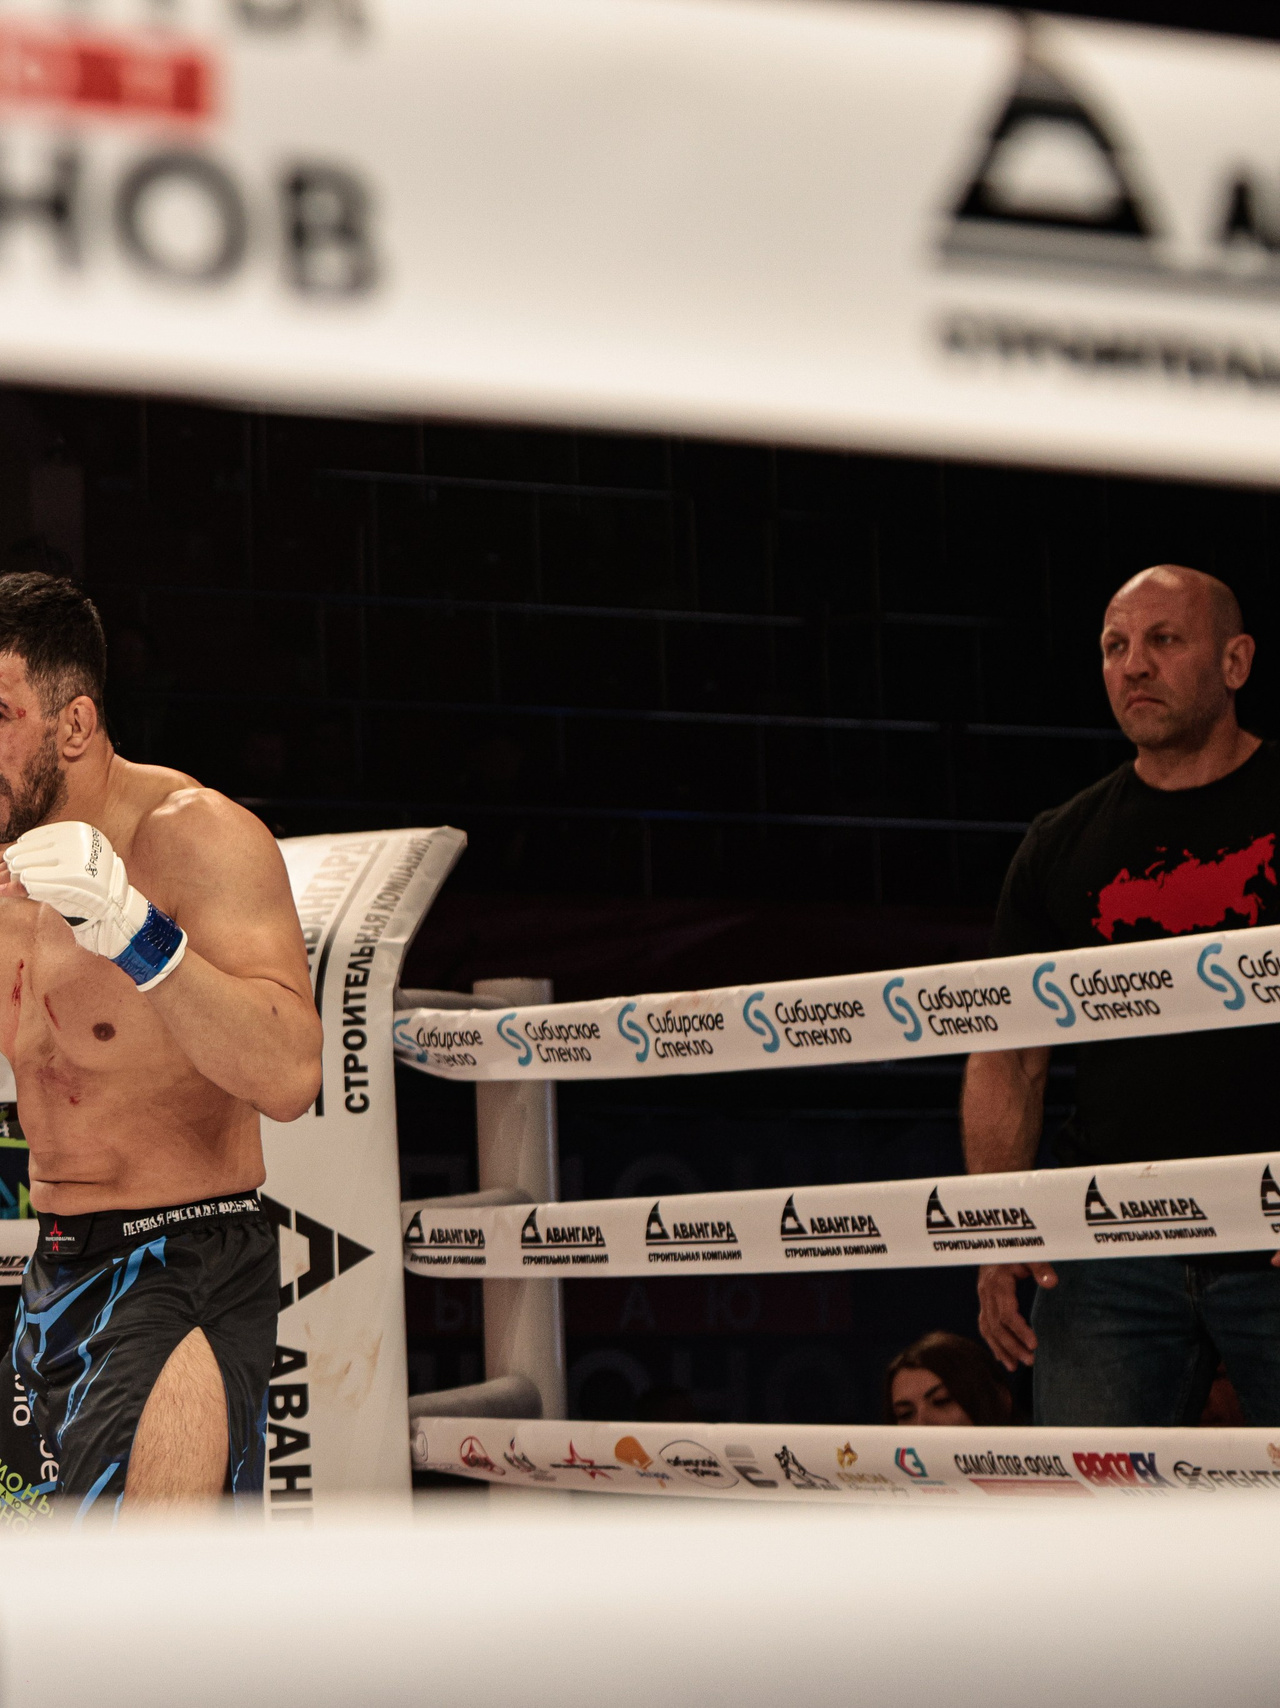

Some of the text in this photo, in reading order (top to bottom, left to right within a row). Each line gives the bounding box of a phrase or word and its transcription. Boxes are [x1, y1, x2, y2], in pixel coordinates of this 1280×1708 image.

[342, 837, 434, 1115] СТРОИТЕЛЬНАЯ КОМПАНИЯ
[1070, 967, 1174, 1000] Сибирское
[917, 983, 1012, 1015] Сибирское
[1081, 998, 1161, 1022] Стекло
[647, 1011, 725, 1037] Сибирское
[775, 995, 866, 1030] Сибирское
[524, 1020, 601, 1044] Сибирское
[785, 1024, 853, 1048] Стекло
[928, 1014, 999, 1037] Стекло
[416, 1026, 484, 1050] Сибирское
[654, 1038, 714, 1060] Стекло
[536, 1045, 592, 1064] Стекло
[958, 1208, 1036, 1230] АВАНГАРД
[1120, 1198, 1208, 1221] АВАНГАРД
[429, 1228, 487, 1247] АВАНГАРД
[546, 1226, 606, 1247] АВАНГАРД
[673, 1221, 738, 1243] АВАНГАРД
[811, 1214, 881, 1238] АВАНГАРД
[1094, 1227, 1217, 1244] СТРОИТЕЛЬНАЯ КОМПАНИЯ
[785, 1243, 888, 1259] СТРОИТЕЛЬНАЯ КОМПАНИЯ
[933, 1236, 1045, 1251] СТРОИТЕЛЬНАЯ КОМПАНИЯ
[522, 1253, 609, 1266] СТРОИТЕЛЬНАЯ КОМПАНИЯ
[648, 1250, 742, 1263] СТРОИТЕЛЬНАЯ КОМПАНИЯ
[954, 1451, 1073, 1478] САМОЙЛОВ ФОНД
